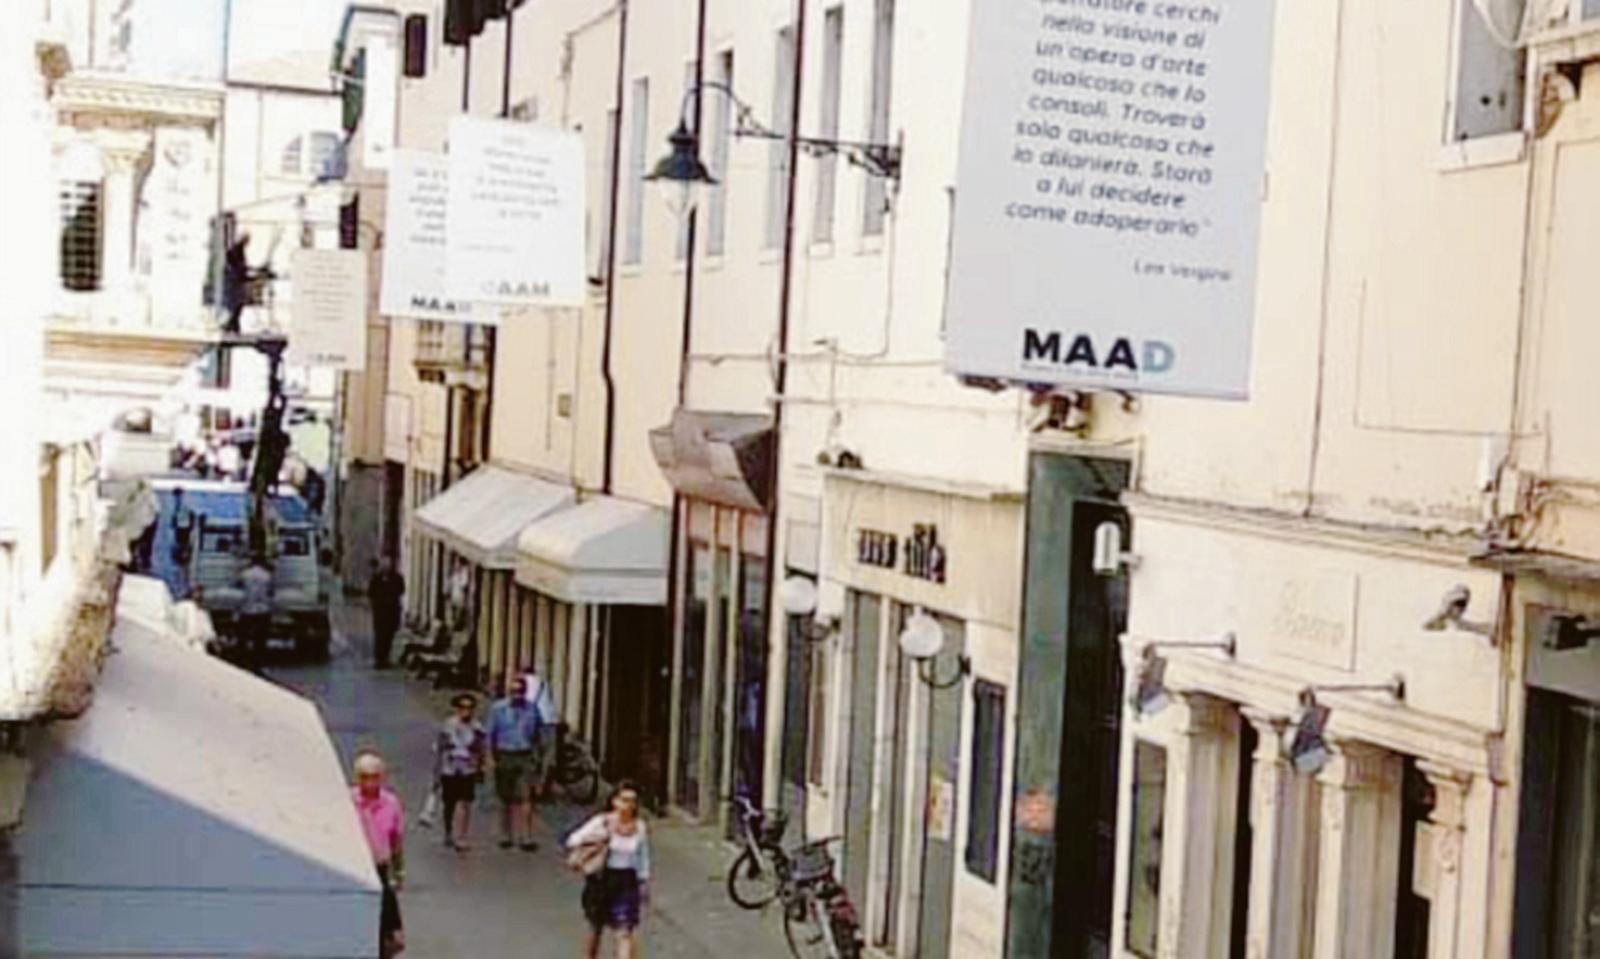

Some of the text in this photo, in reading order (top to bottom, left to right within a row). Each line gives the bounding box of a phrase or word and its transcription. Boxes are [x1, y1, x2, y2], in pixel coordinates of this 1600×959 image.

[1102, 22, 1178, 47] visione
[1140, 81, 1178, 101] che
[1175, 139, 1215, 159] che
[1036, 178, 1052, 194] a
[1089, 183, 1186, 210] decidere
[1004, 201, 1068, 223] come
[1023, 328, 1175, 372] MAAD
